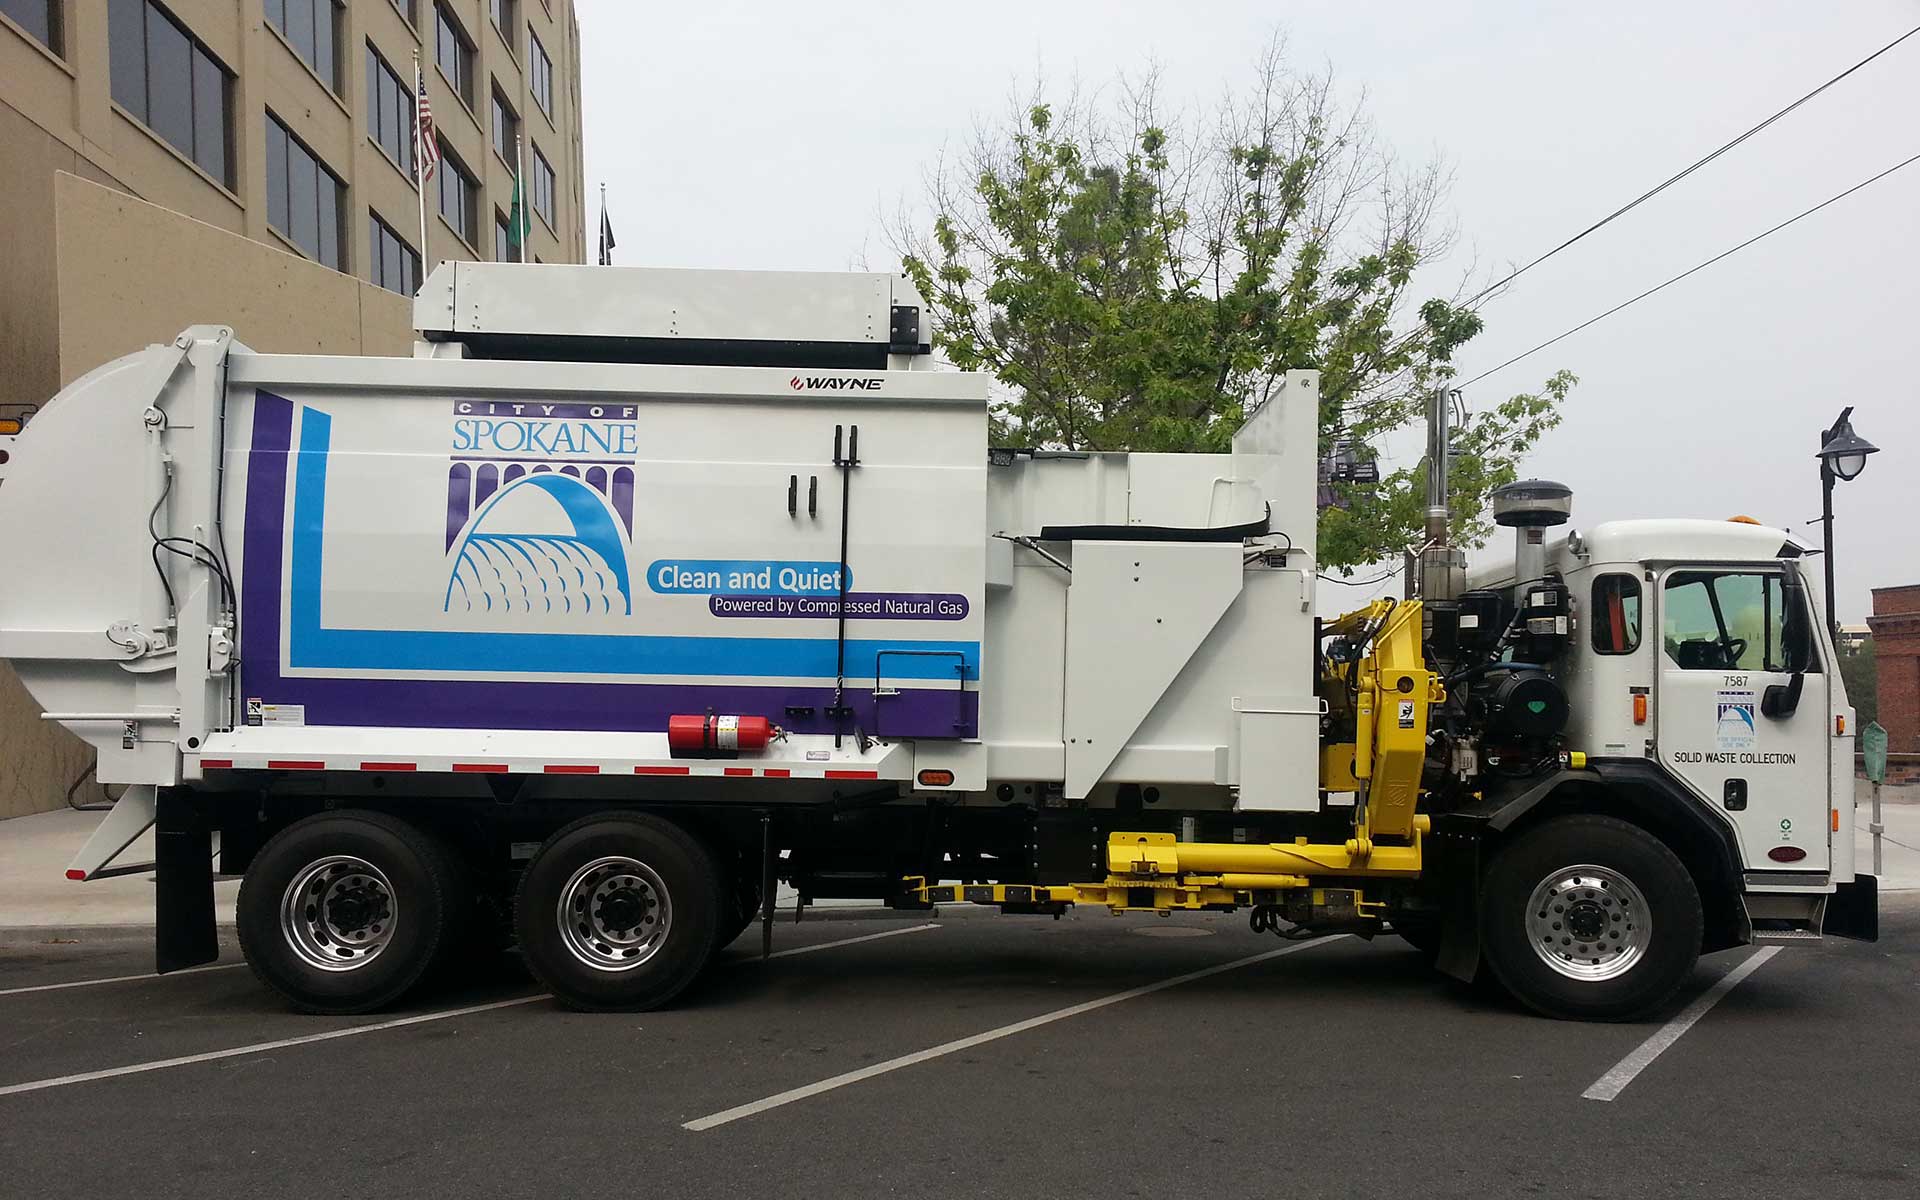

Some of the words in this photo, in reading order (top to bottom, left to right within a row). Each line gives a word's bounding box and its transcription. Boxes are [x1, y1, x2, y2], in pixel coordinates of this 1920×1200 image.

[806, 377, 885, 390] WAYNE
[458, 402, 555, 416] CITY
[589, 406, 634, 418] OF
[453, 419, 638, 455] SPOKANE
[658, 565, 721, 589] Clean
[728, 566, 771, 590] and
[778, 567, 841, 593] Quiet
[715, 597, 773, 612] Powered
[778, 597, 795, 616] by
[885, 599, 934, 614] Natural
[938, 600, 963, 615] Gas
[1723, 675, 1749, 687] 7587
[1674, 752, 1702, 763] SOLID
[1705, 752, 1737, 764] WASTE
[1740, 753, 1796, 765] COLLECTION
